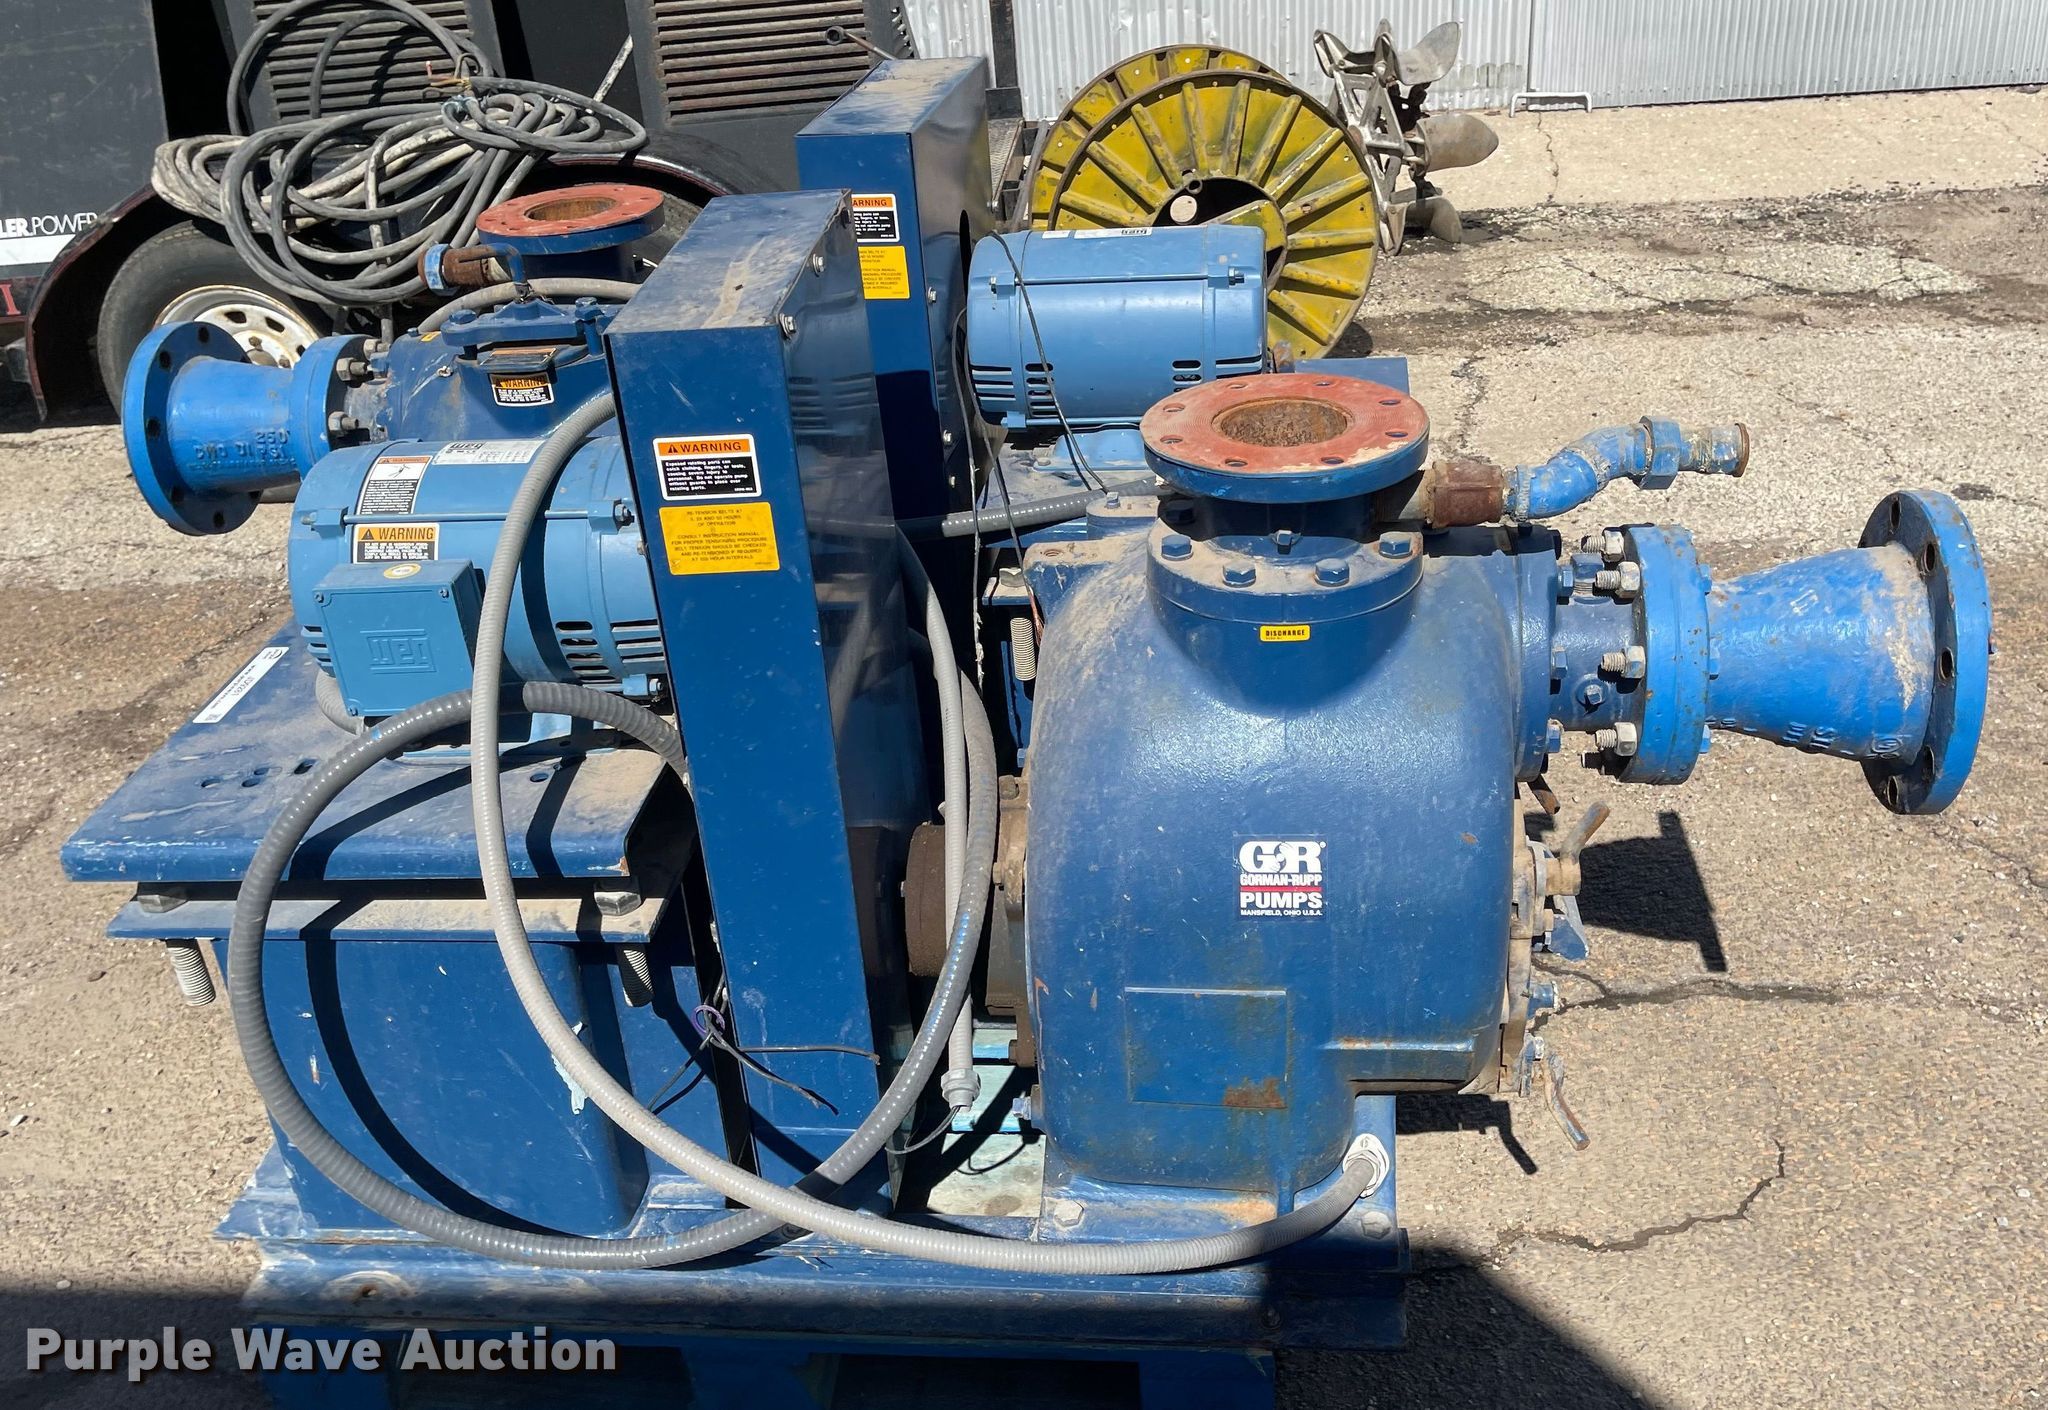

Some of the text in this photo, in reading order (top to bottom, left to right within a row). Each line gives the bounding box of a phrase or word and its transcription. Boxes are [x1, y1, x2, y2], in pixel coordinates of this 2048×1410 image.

[852, 199, 887, 207] ARNING
[679, 441, 742, 454] WARNING
[379, 527, 434, 541] WARNING
[1265, 629, 1305, 637] DISCHARGE
[1240, 873, 1323, 887] GORMAN-RUPP
[1240, 891, 1323, 909] PUMPS
[1240, 909, 1283, 917] MANSFIELD,
